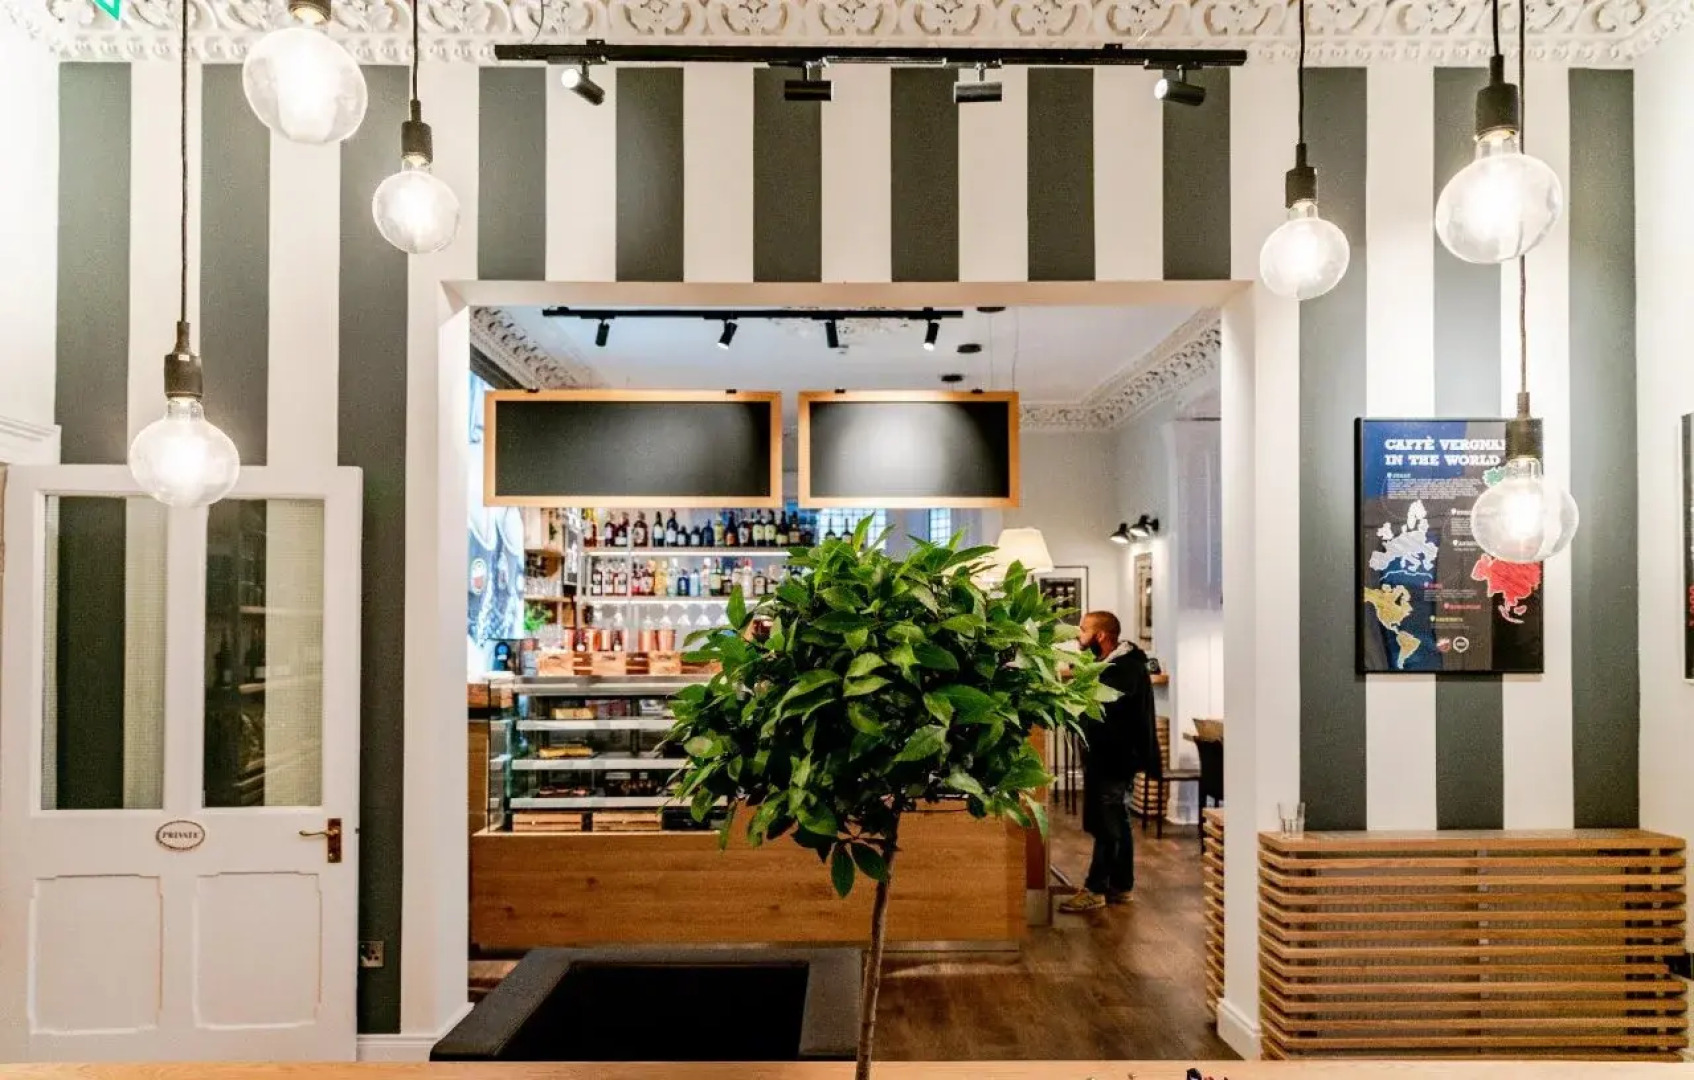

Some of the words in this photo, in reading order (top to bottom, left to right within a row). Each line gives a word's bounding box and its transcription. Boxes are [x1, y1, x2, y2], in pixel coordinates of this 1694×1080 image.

[1384, 435, 1435, 451] CAFFÈ
[1384, 453, 1403, 466] IN
[1408, 453, 1439, 467] THE
[1443, 453, 1501, 467] WORLD
[162, 831, 199, 839] PRIVATE
